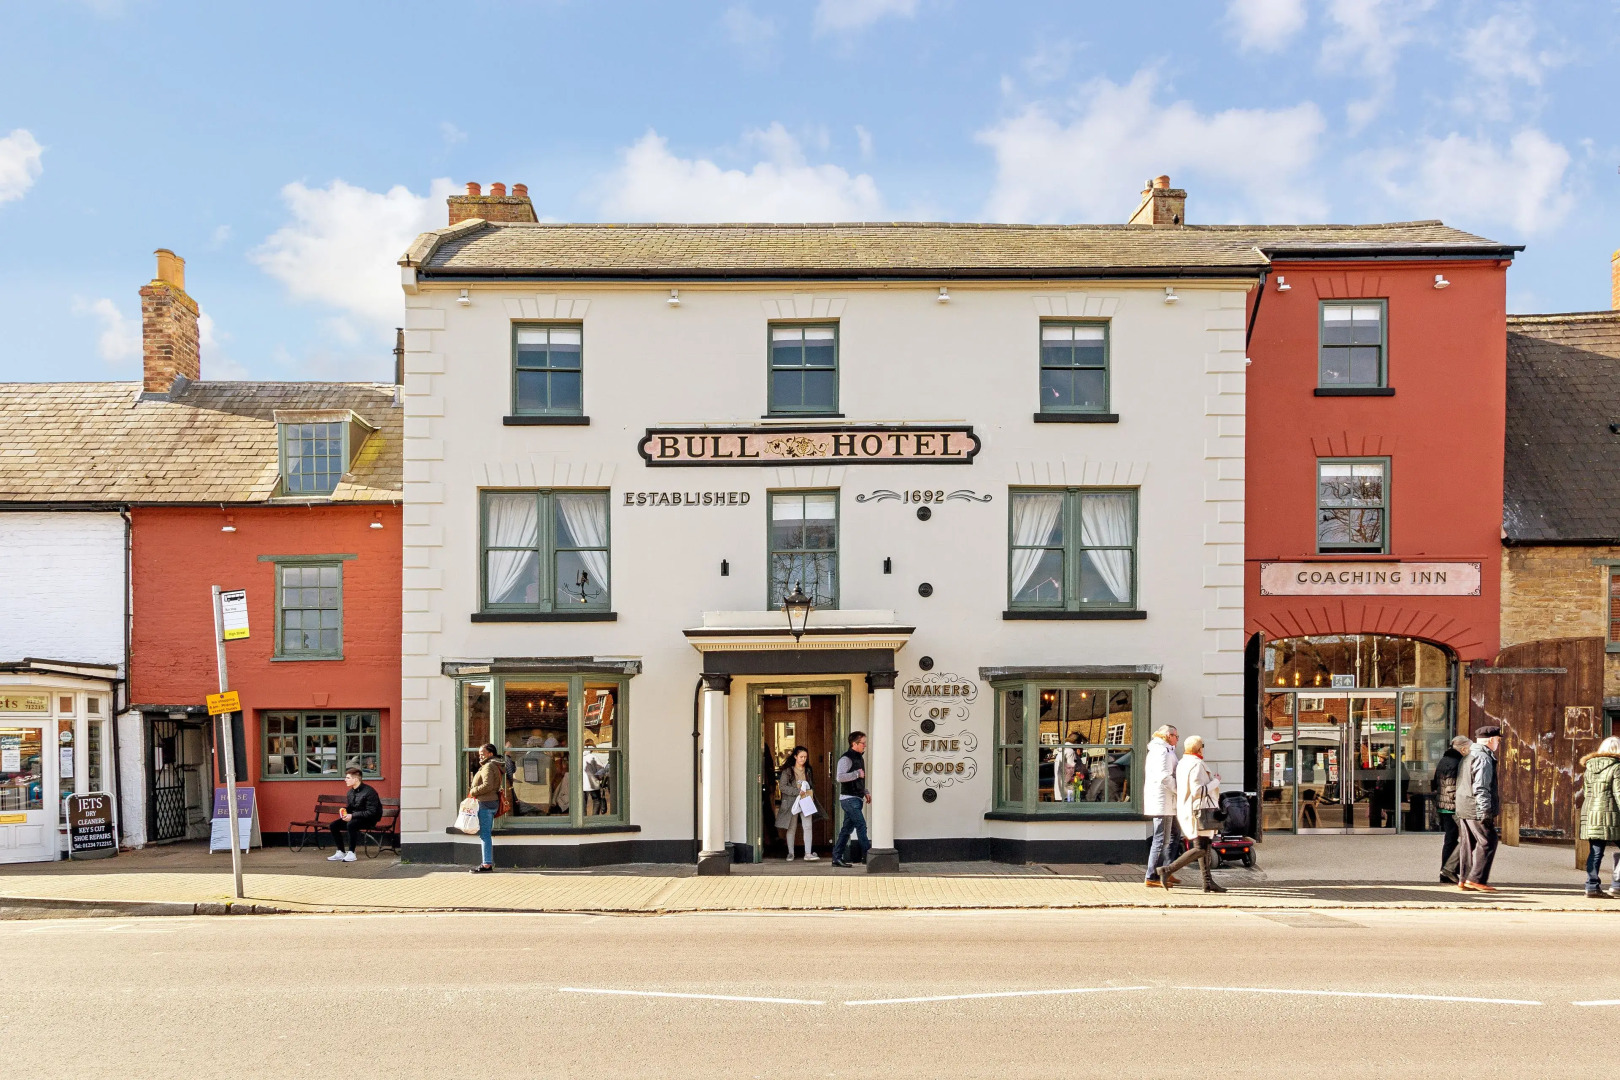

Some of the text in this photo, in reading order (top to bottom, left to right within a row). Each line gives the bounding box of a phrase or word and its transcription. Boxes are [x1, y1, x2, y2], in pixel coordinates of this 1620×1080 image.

[656, 433, 962, 459] BULL HOTEL
[623, 491, 751, 507] ESTABLISHED
[903, 489, 945, 504] 1692
[1296, 571, 1447, 584] COACHING INN
[907, 685, 970, 697] MAKERS
[928, 707, 950, 719] OF
[920, 739, 960, 752] FINE
[912, 762, 965, 775] FOODS
[78, 797, 103, 812] JETS
